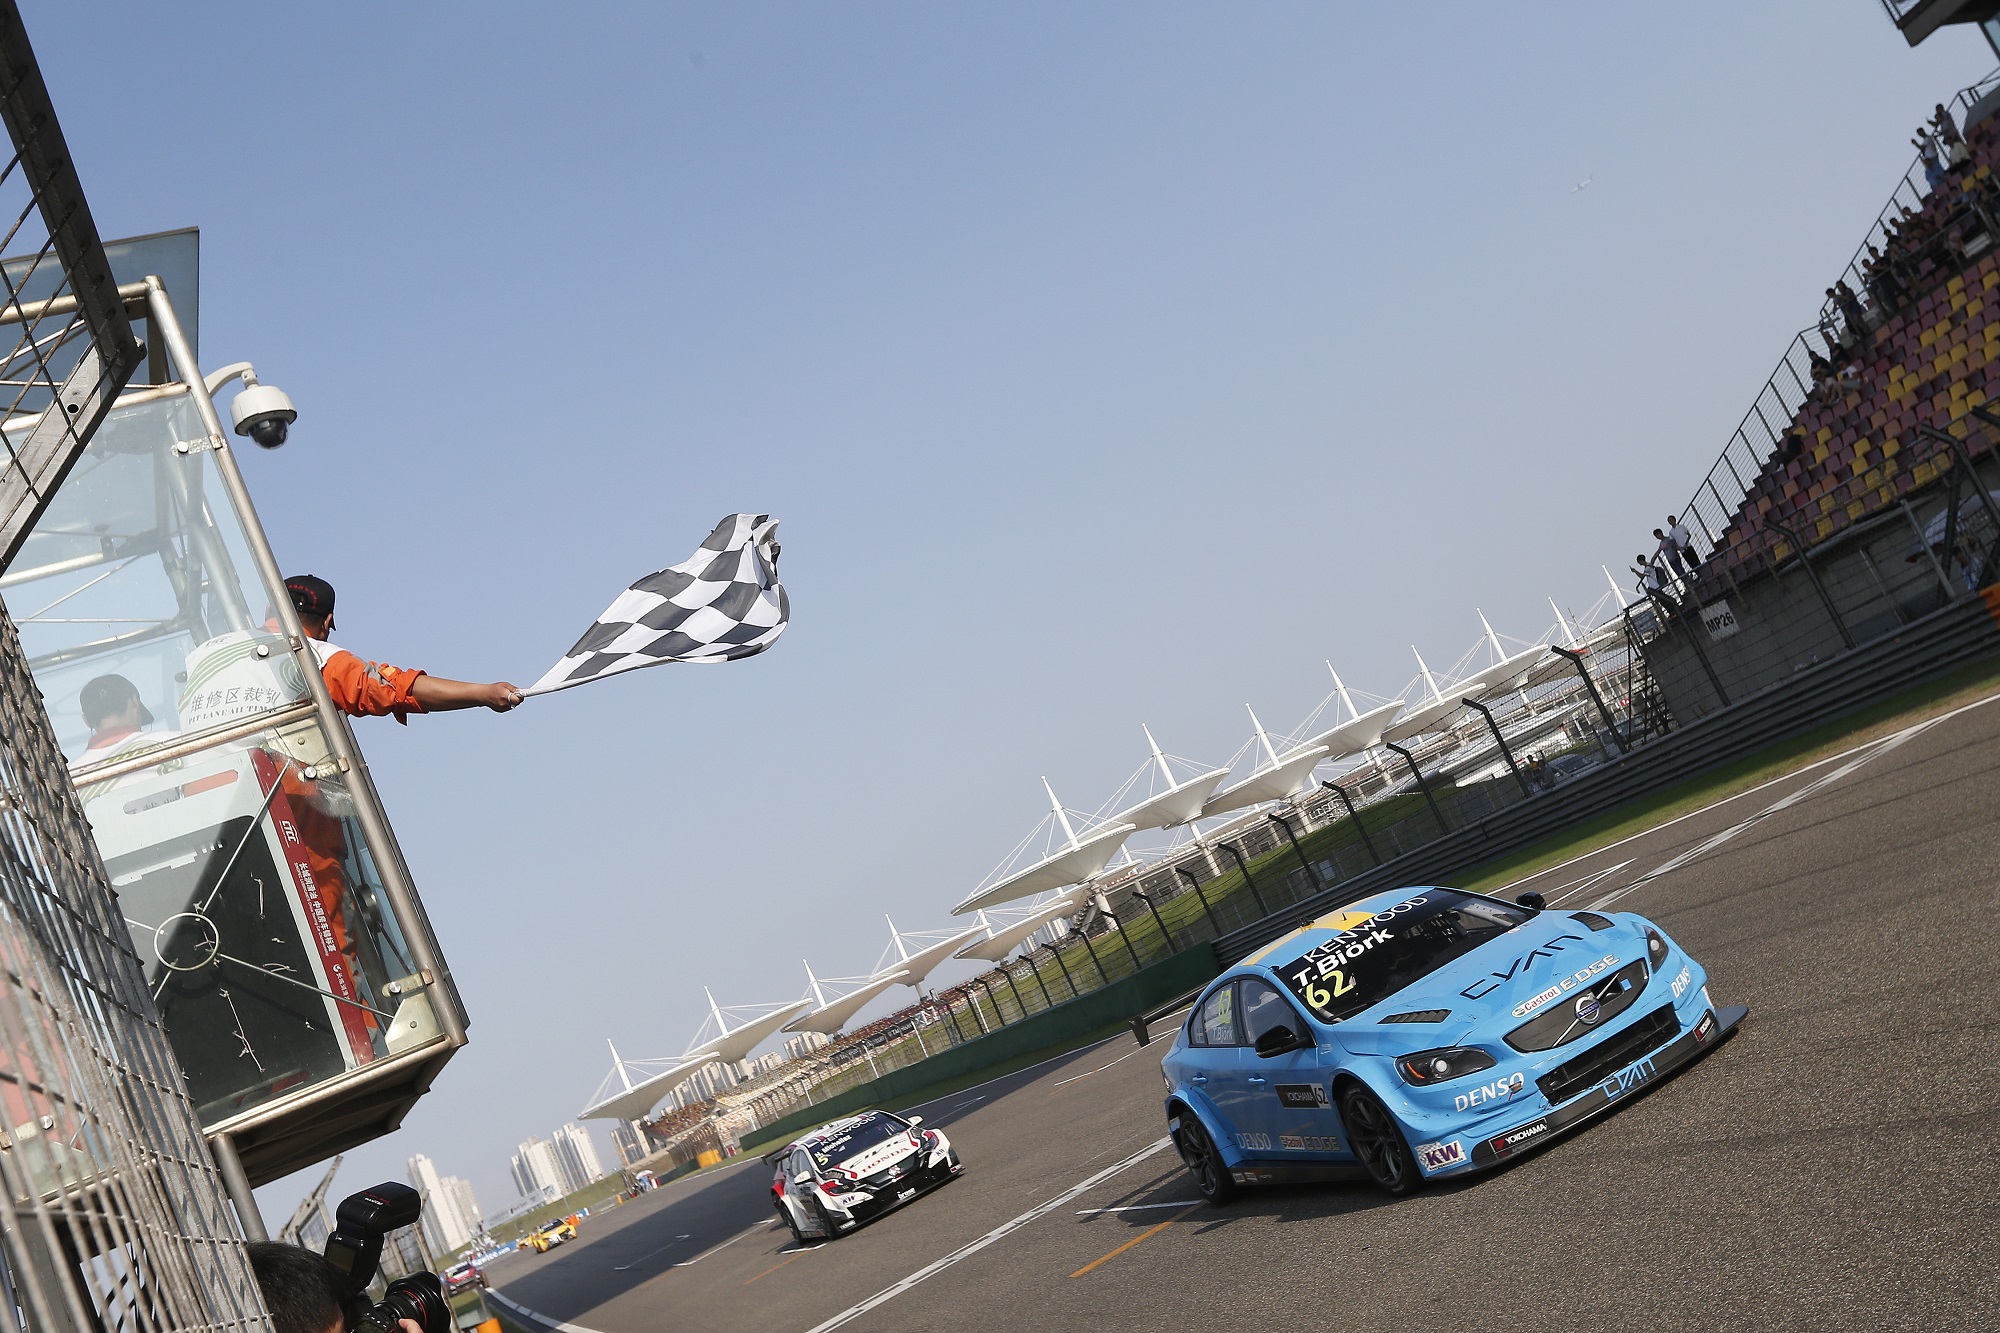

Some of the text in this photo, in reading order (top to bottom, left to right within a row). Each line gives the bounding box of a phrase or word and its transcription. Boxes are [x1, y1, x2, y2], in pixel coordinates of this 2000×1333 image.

[1706, 612, 1734, 633] MP26
[1302, 896, 1428, 964] KENWOOD
[1305, 969, 1355, 1009] 62
[1524, 953, 1621, 1012] Castrol EDGE
[1671, 965, 1691, 999] DENS
[1313, 1087, 1330, 1105] 62
[1454, 1072, 1525, 1112] DENSO
[820, 1116, 876, 1147] KENWOOD
[1236, 1132, 1272, 1151] DENSO
[1304, 1136, 1341, 1151] EDGE
[1505, 1123, 1548, 1145] YOKOHAMA
[817, 1154, 829, 1166] 5
[862, 1147, 910, 1173] HONDA
[1425, 1142, 1459, 1167] KW
